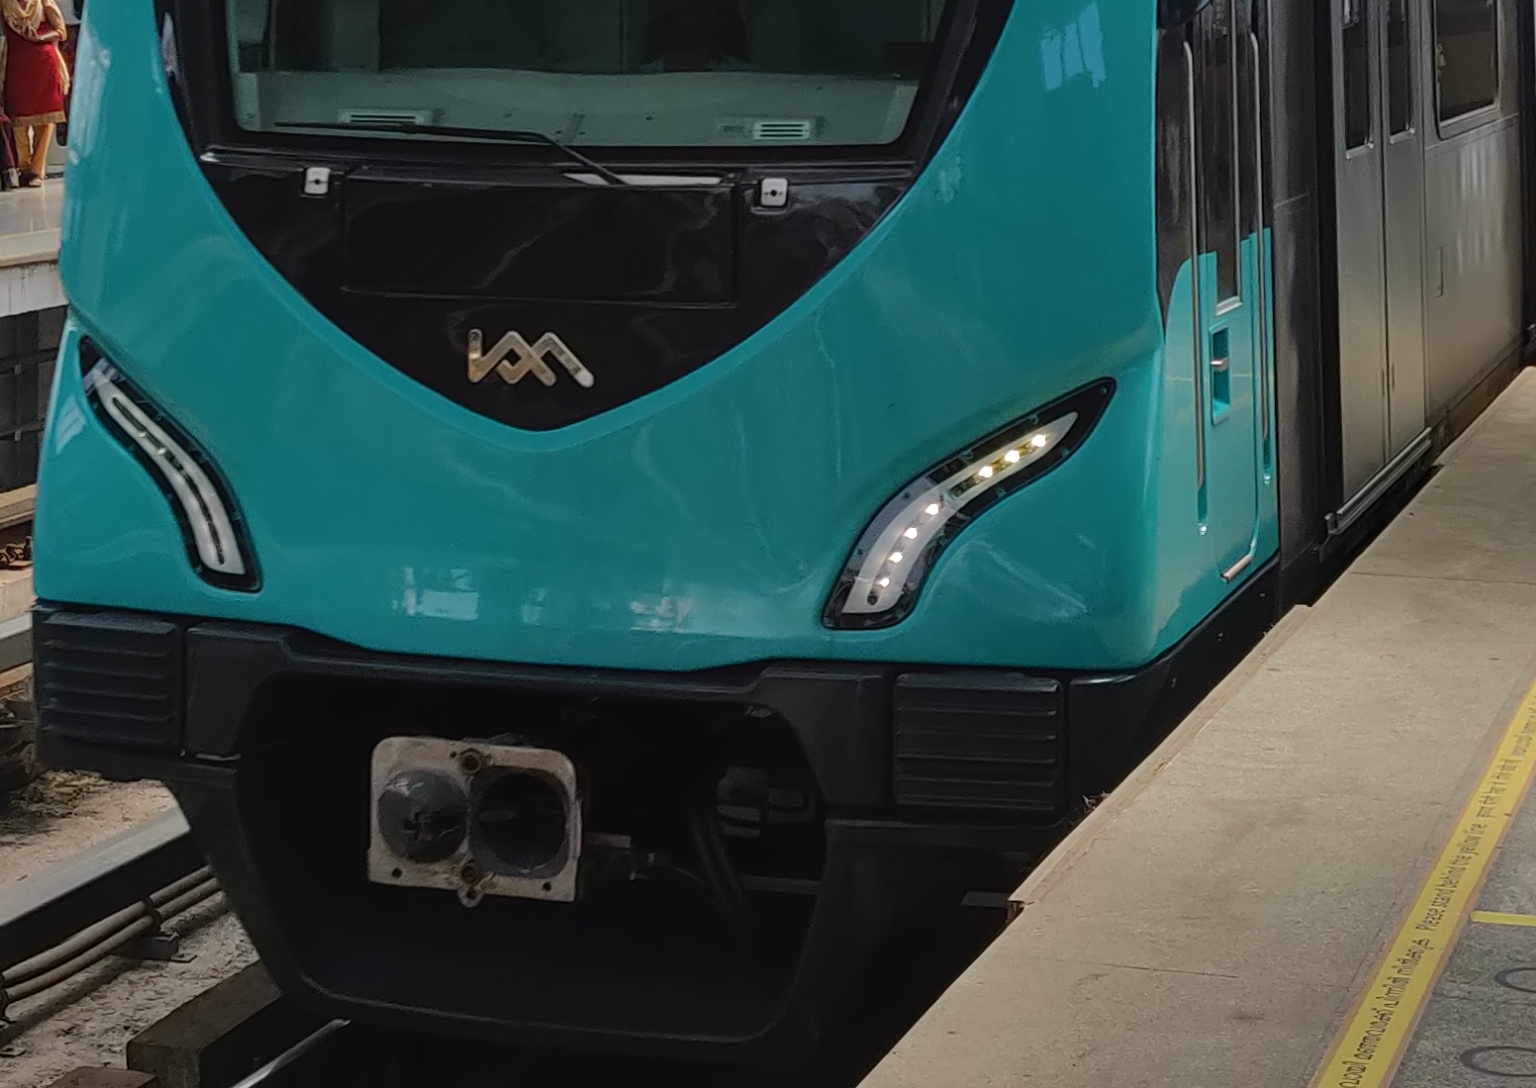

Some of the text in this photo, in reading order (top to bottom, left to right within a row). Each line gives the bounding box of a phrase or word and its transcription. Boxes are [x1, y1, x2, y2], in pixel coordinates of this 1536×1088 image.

[1435, 865, 1465, 890] behind
[1426, 887, 1454, 909] stand
[1414, 906, 1446, 931] Please
